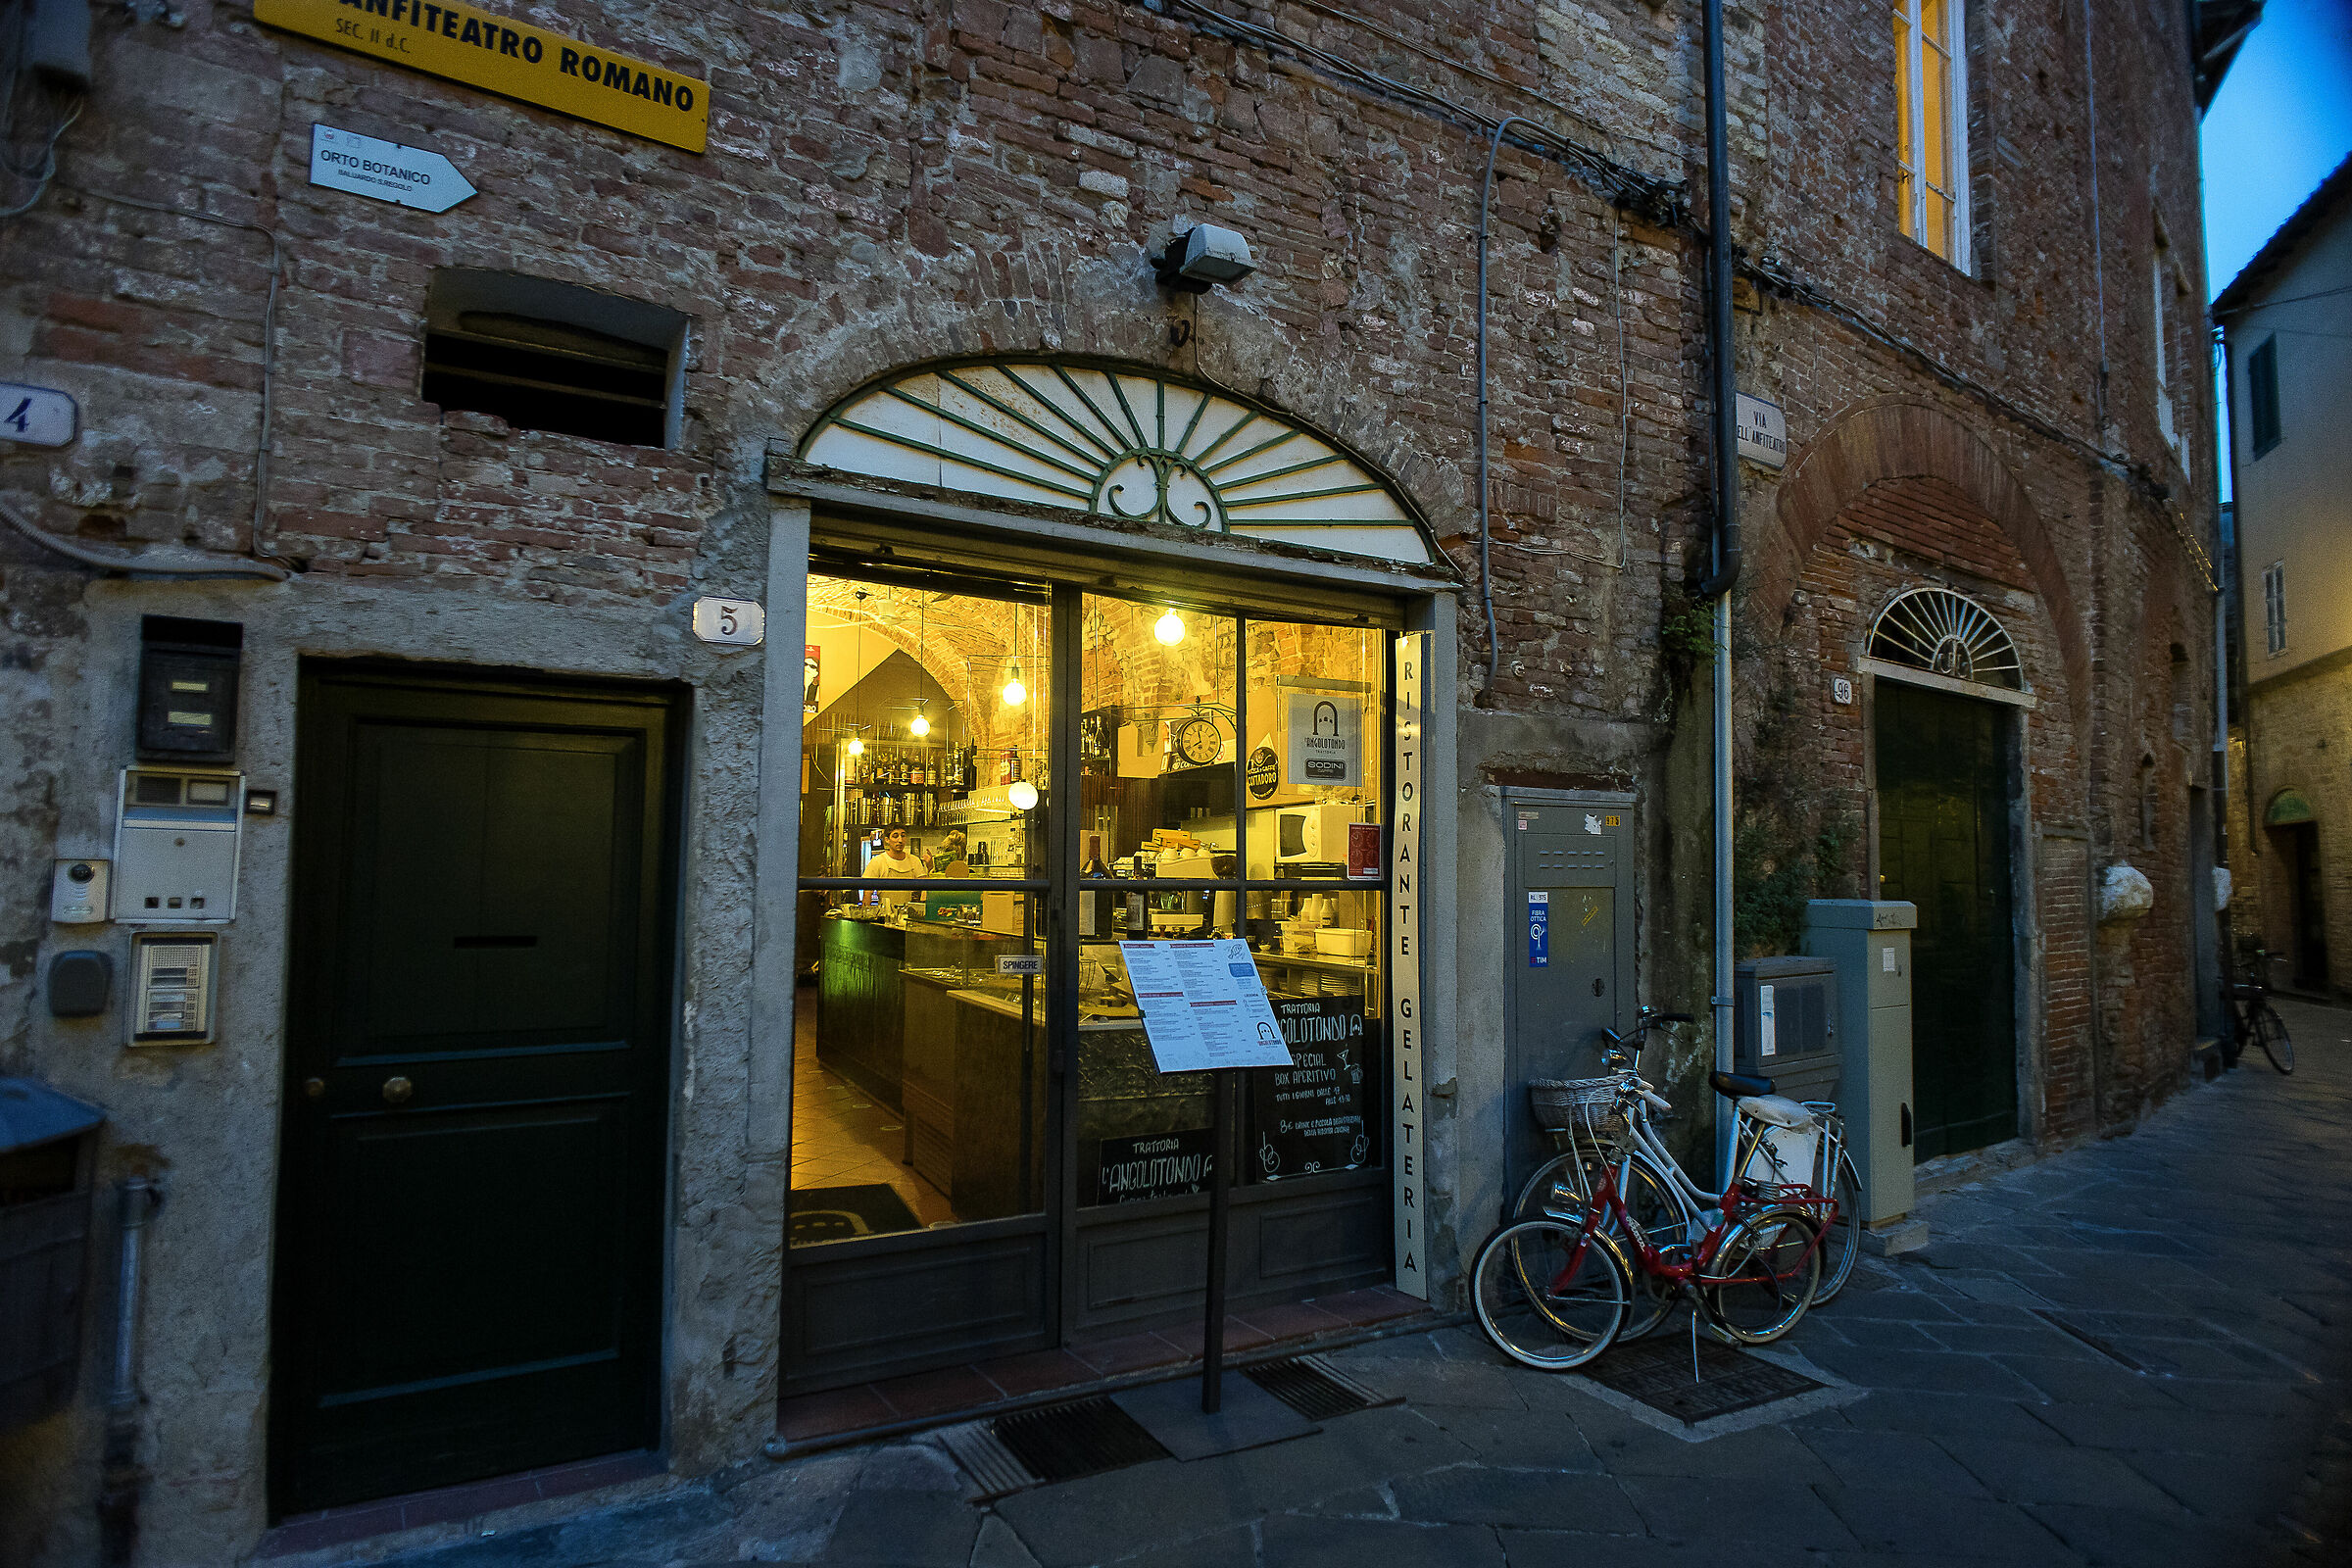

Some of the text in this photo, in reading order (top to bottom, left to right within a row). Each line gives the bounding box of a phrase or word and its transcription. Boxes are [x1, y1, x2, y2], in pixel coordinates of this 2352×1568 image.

[336, 18, 364, 40] SEC.
[386, 33, 412, 54] d.C.
[559, 46, 695, 113] ROMANO
[320, 149, 431, 185] ORTO BOTANICO
[338, 169, 376, 183] BALUARDO
[3, 398, 32, 432] 4
[1753, 411, 1767, 428] VIA
[1738, 424, 1785, 455] ELL'ANFITEATRO
[720, 605, 739, 636] 5
[1838, 682, 1849, 700] 96
[1307, 760, 1344, 769] SODINI
[1398, 661, 1414, 956] RISTORANTE
[1003, 960, 1038, 970] SPINGERE
[1280, 1003, 1321, 1015] TRATTORIA
[1277, 1013, 1347, 1045] GOLOTONDO
[1291, 1053, 1327, 1068] SPECIAL
[1274, 1067, 1337, 1086] BOX APERITIVO
[1132, 1138, 1180, 1154] TRATTORIA
[1399, 998, 1417, 1273] GELATERIA
[1102, 1152, 1200, 1195] L'ANGOLOTONDO
